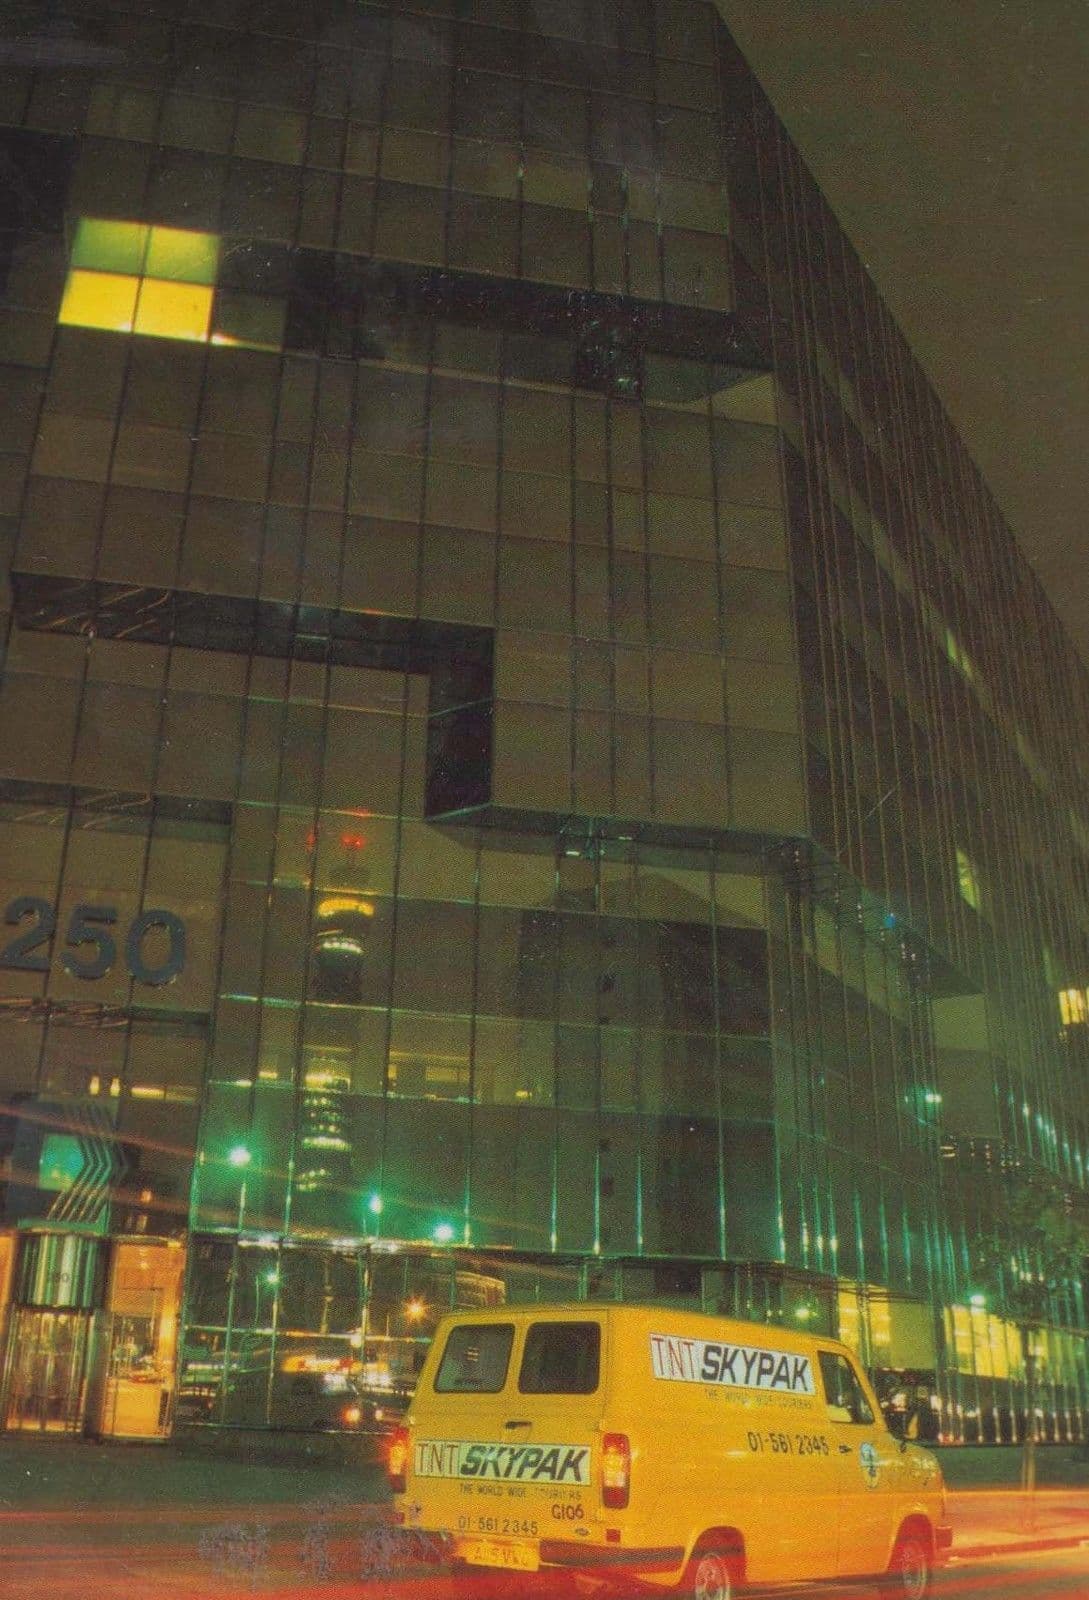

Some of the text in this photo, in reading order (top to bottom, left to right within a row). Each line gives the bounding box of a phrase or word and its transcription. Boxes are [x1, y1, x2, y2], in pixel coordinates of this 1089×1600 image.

[0, 895, 187, 985] 250
[652, 1337, 809, 1391] TNT SKYPAK
[416, 1443, 589, 1482] TNT SKYPAK
[502, 1518, 538, 1535] 2345
